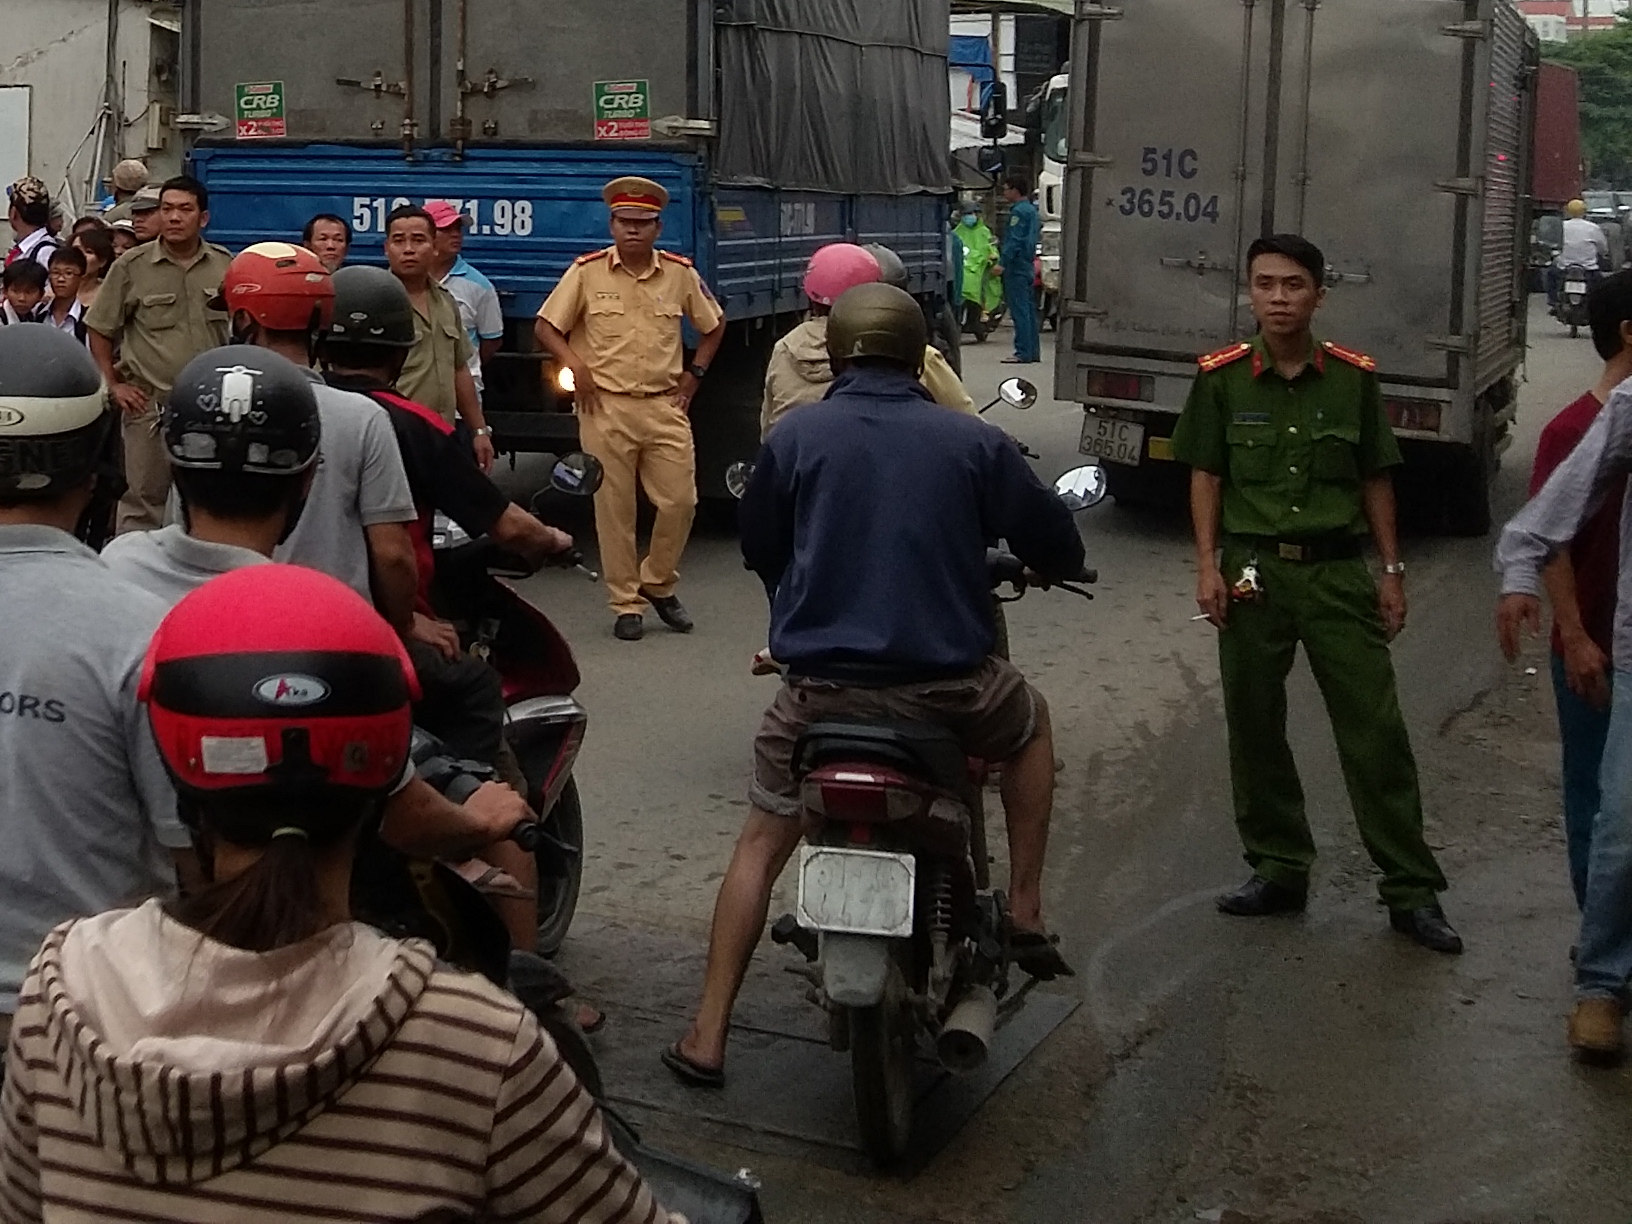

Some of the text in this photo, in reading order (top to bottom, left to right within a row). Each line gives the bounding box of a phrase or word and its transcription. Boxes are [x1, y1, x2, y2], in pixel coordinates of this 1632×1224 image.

[240, 94, 280, 109] CRB
[599, 93, 644, 109] CRB
[1141, 147, 1199, 179] 51C
[1119, 186, 1220, 224] 365.04
[1097, 419, 1130, 441] 51C
